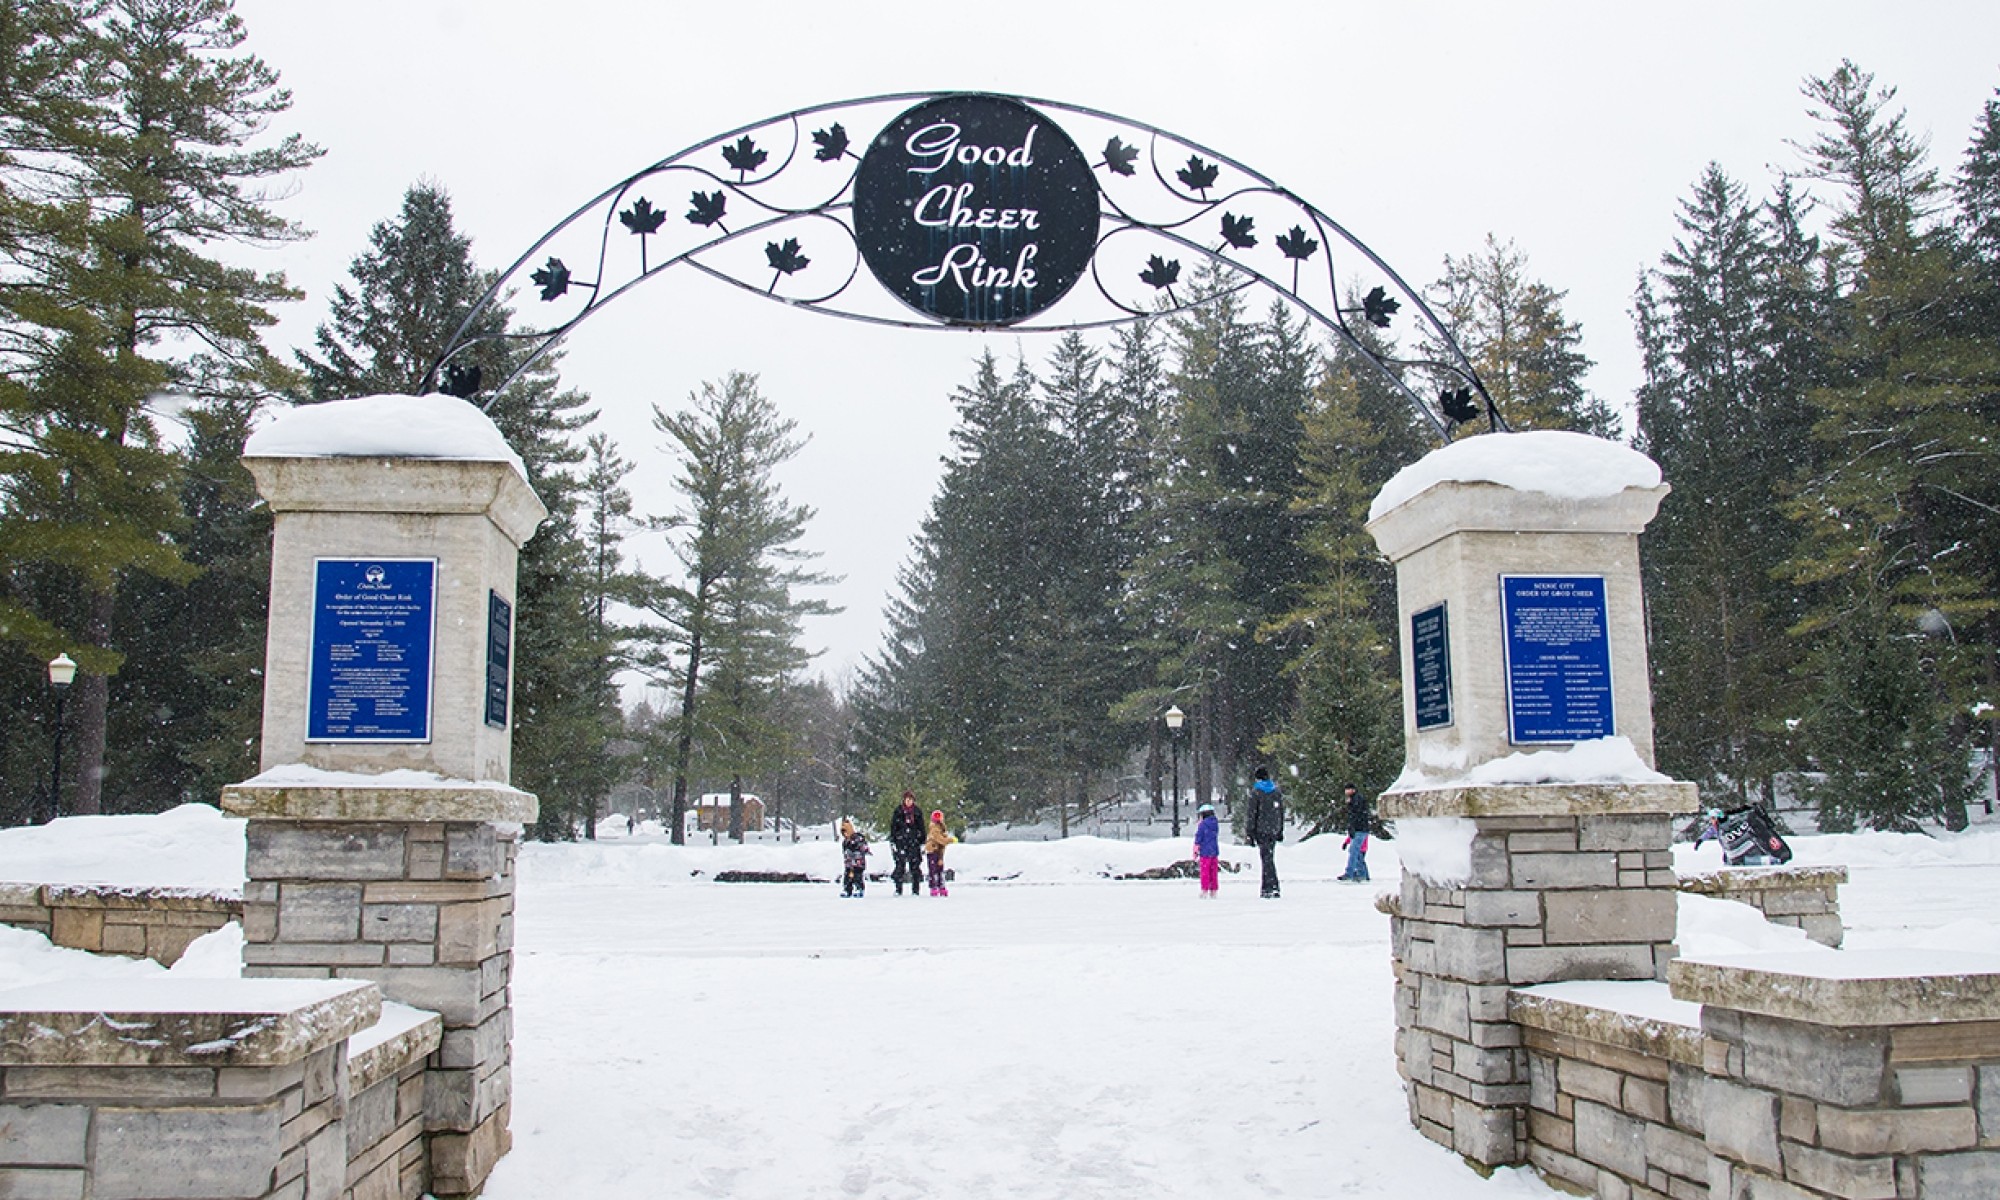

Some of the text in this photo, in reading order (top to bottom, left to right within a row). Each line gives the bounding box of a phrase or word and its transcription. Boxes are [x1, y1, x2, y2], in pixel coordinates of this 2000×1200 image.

[905, 123, 1039, 174] Good
[913, 182, 1040, 231] Cheer
[911, 243, 1039, 294] Rink
